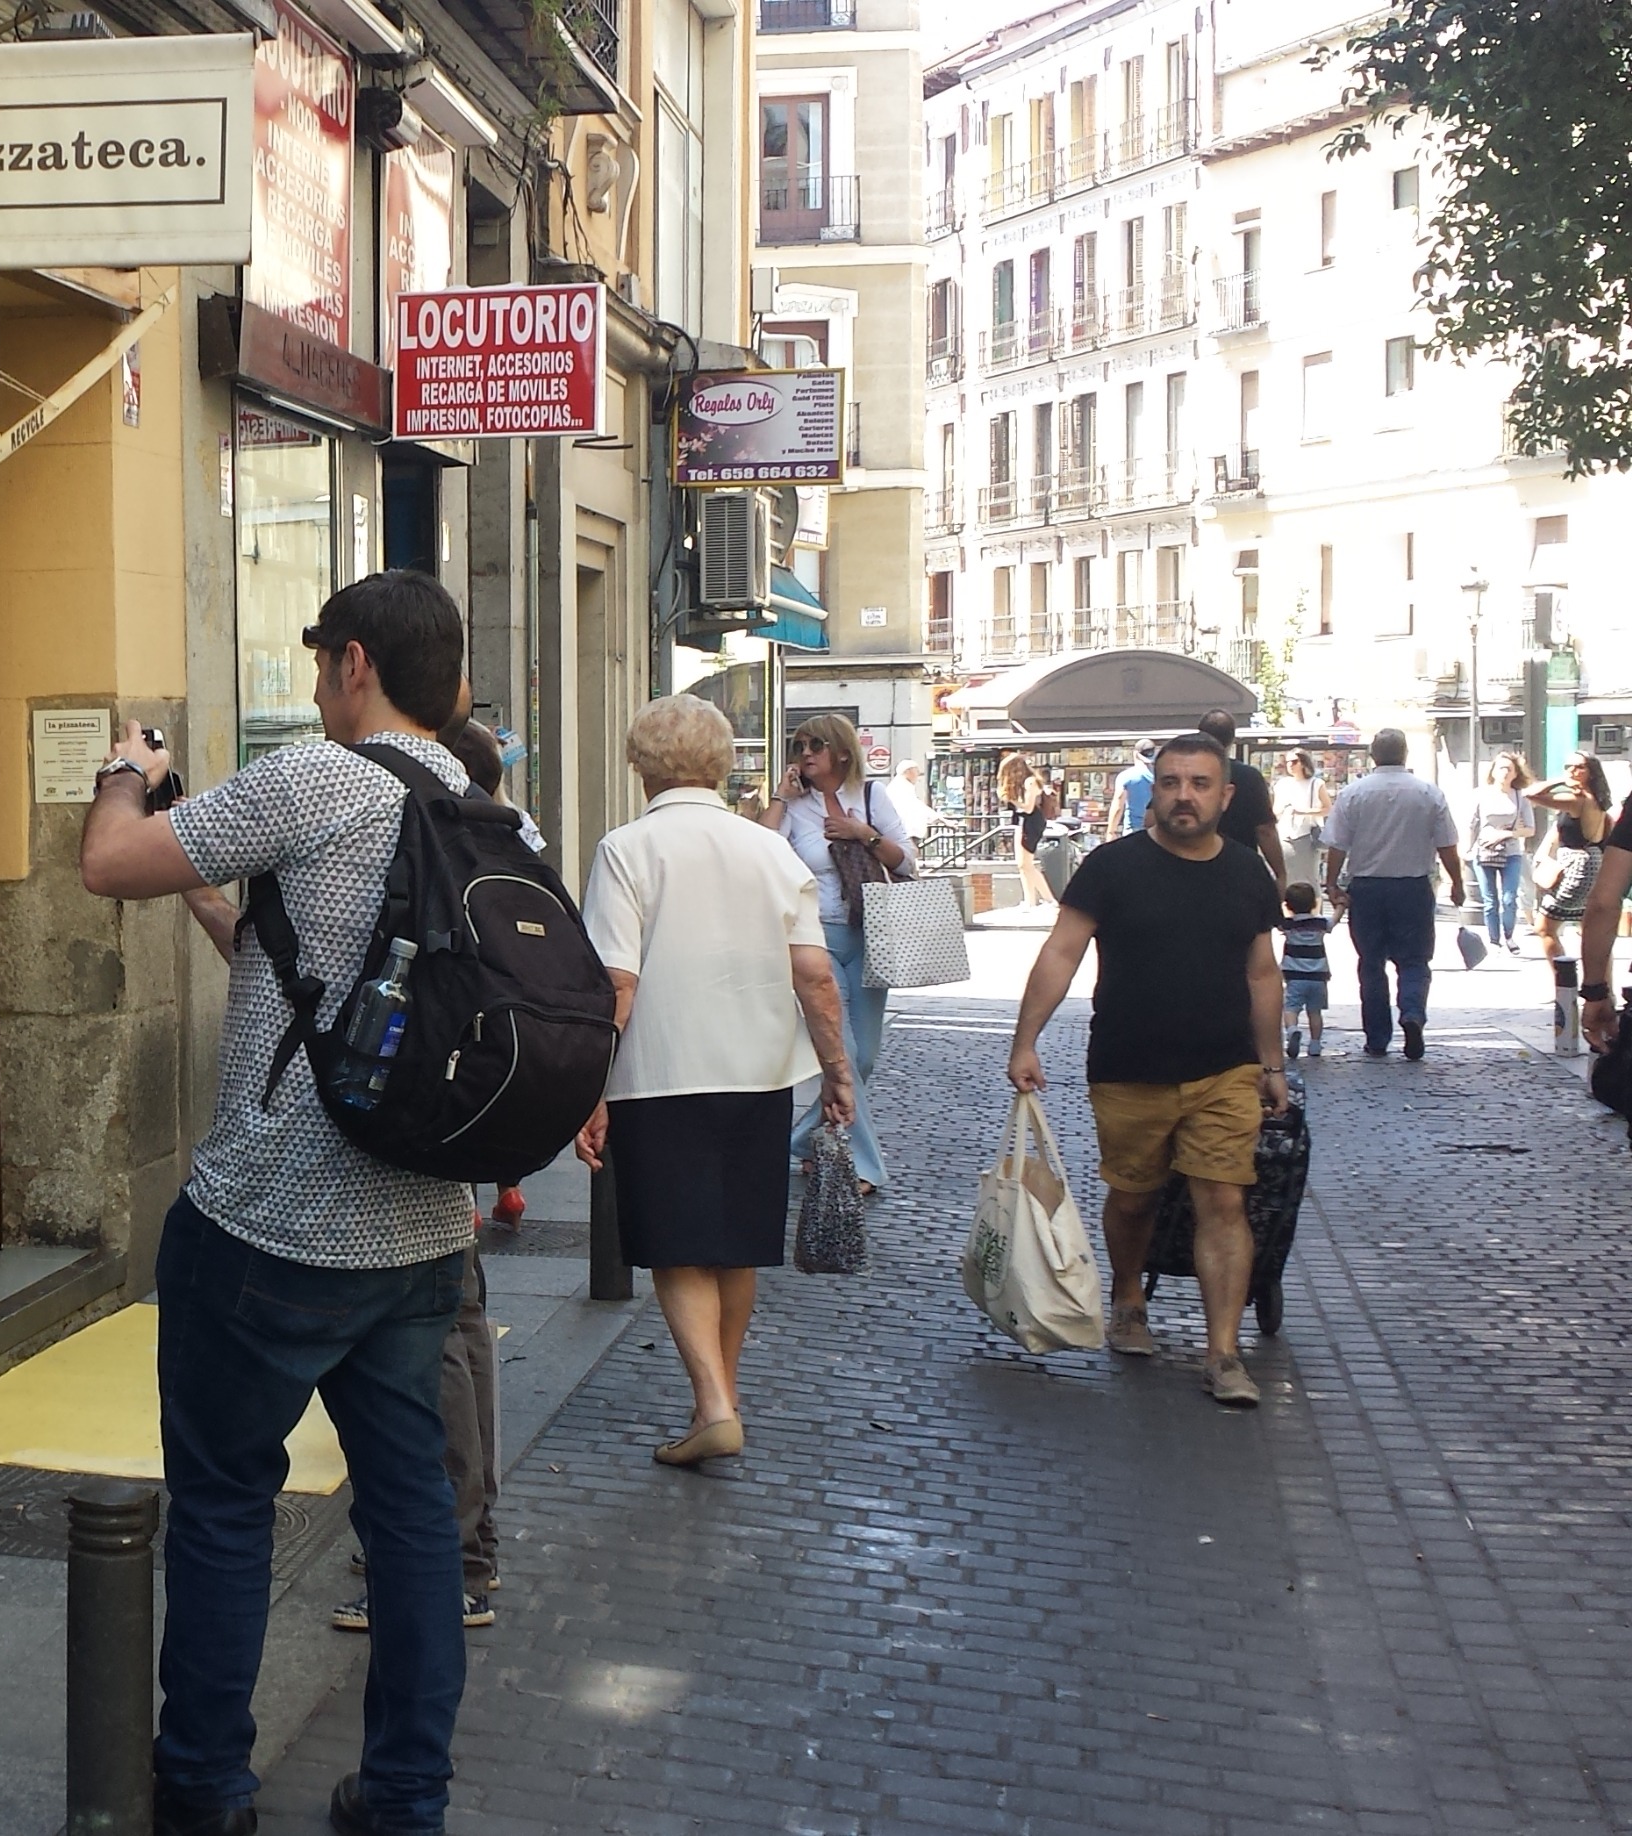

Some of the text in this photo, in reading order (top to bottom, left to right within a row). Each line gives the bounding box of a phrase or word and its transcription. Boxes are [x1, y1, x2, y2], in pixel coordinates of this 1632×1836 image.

[267, 119, 331, 184] INTERNE
[267, 188, 334, 255] RECARGA
[400, 292, 594, 350] LOCUTORIO
[417, 351, 574, 381] INTERNET, ACCESORIOS
[421, 378, 568, 406] RECARGA DE MOVILES
[695, 391, 775, 417] Regalos Orly
[10, 408, 44, 451] RECYCLE
[407, 404, 583, 434] IMPRESION, FOTOCOPIAS...
[688, 465, 828, 481] Tel: 658 664 632
